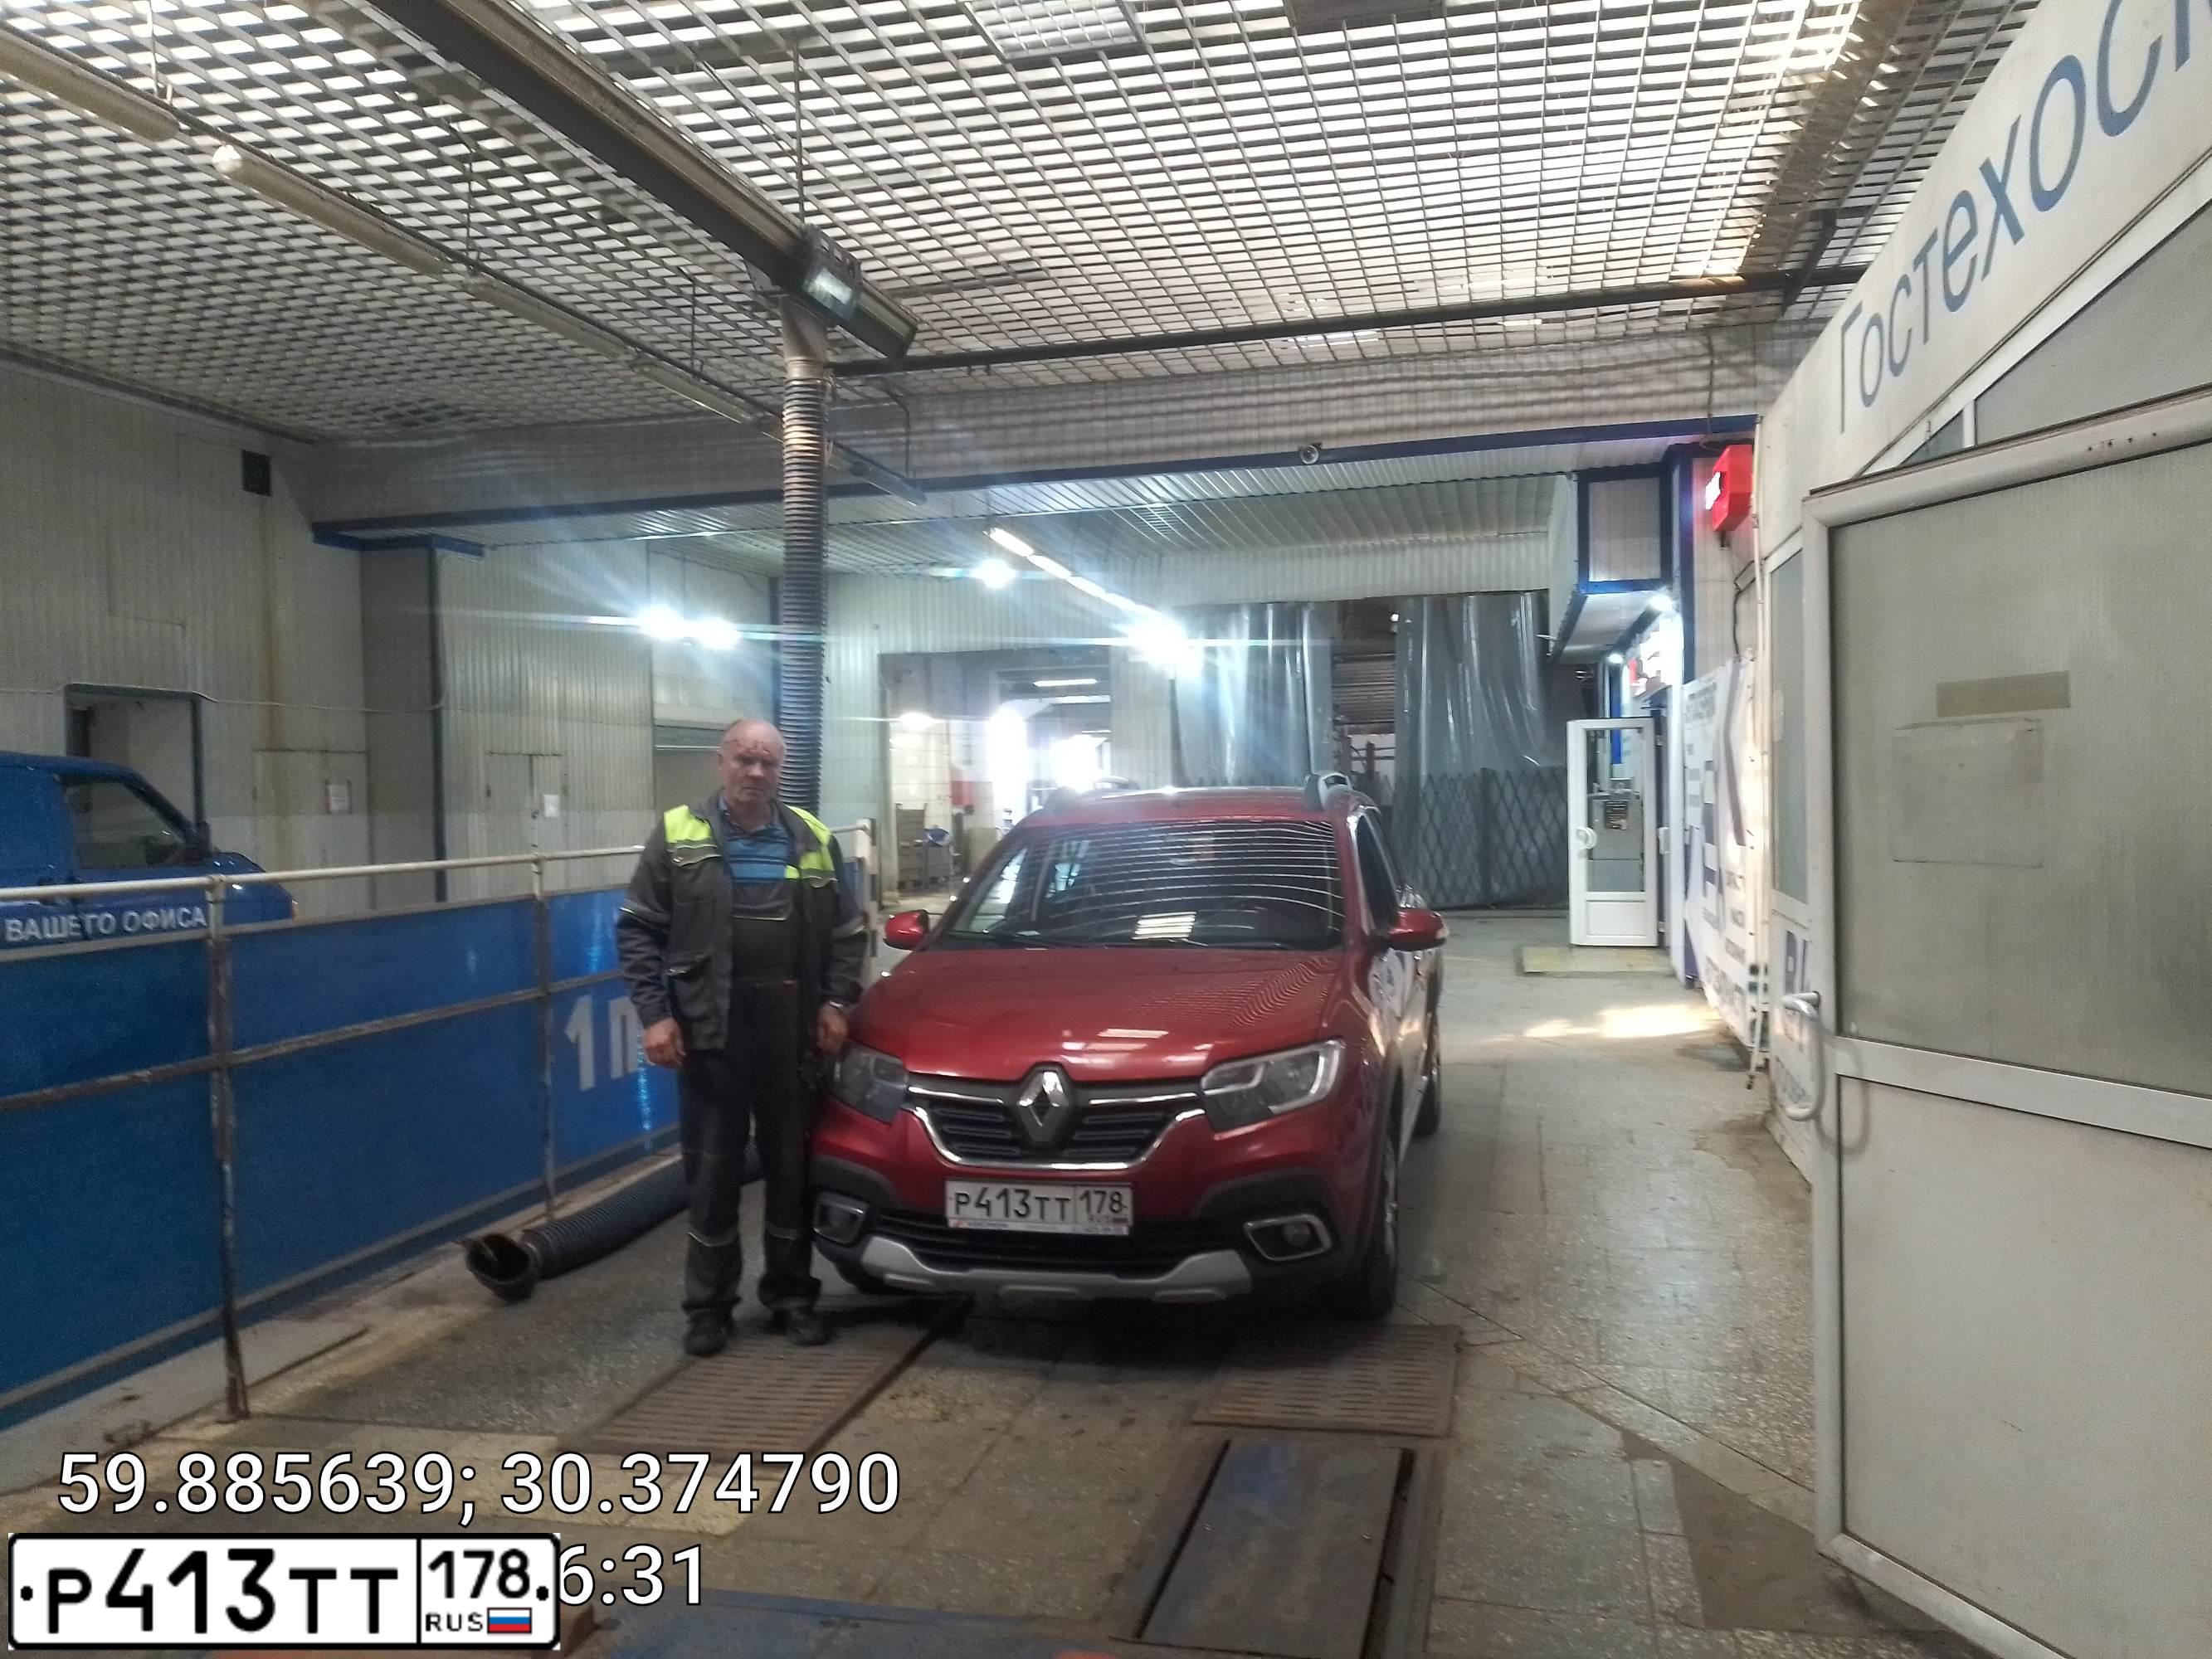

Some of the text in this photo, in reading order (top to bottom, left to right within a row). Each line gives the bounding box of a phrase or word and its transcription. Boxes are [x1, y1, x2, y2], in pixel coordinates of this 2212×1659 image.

[4, 907, 207, 942] ВАШЕГО ОФИСА
[1079, 1190, 1123, 1214] 178
